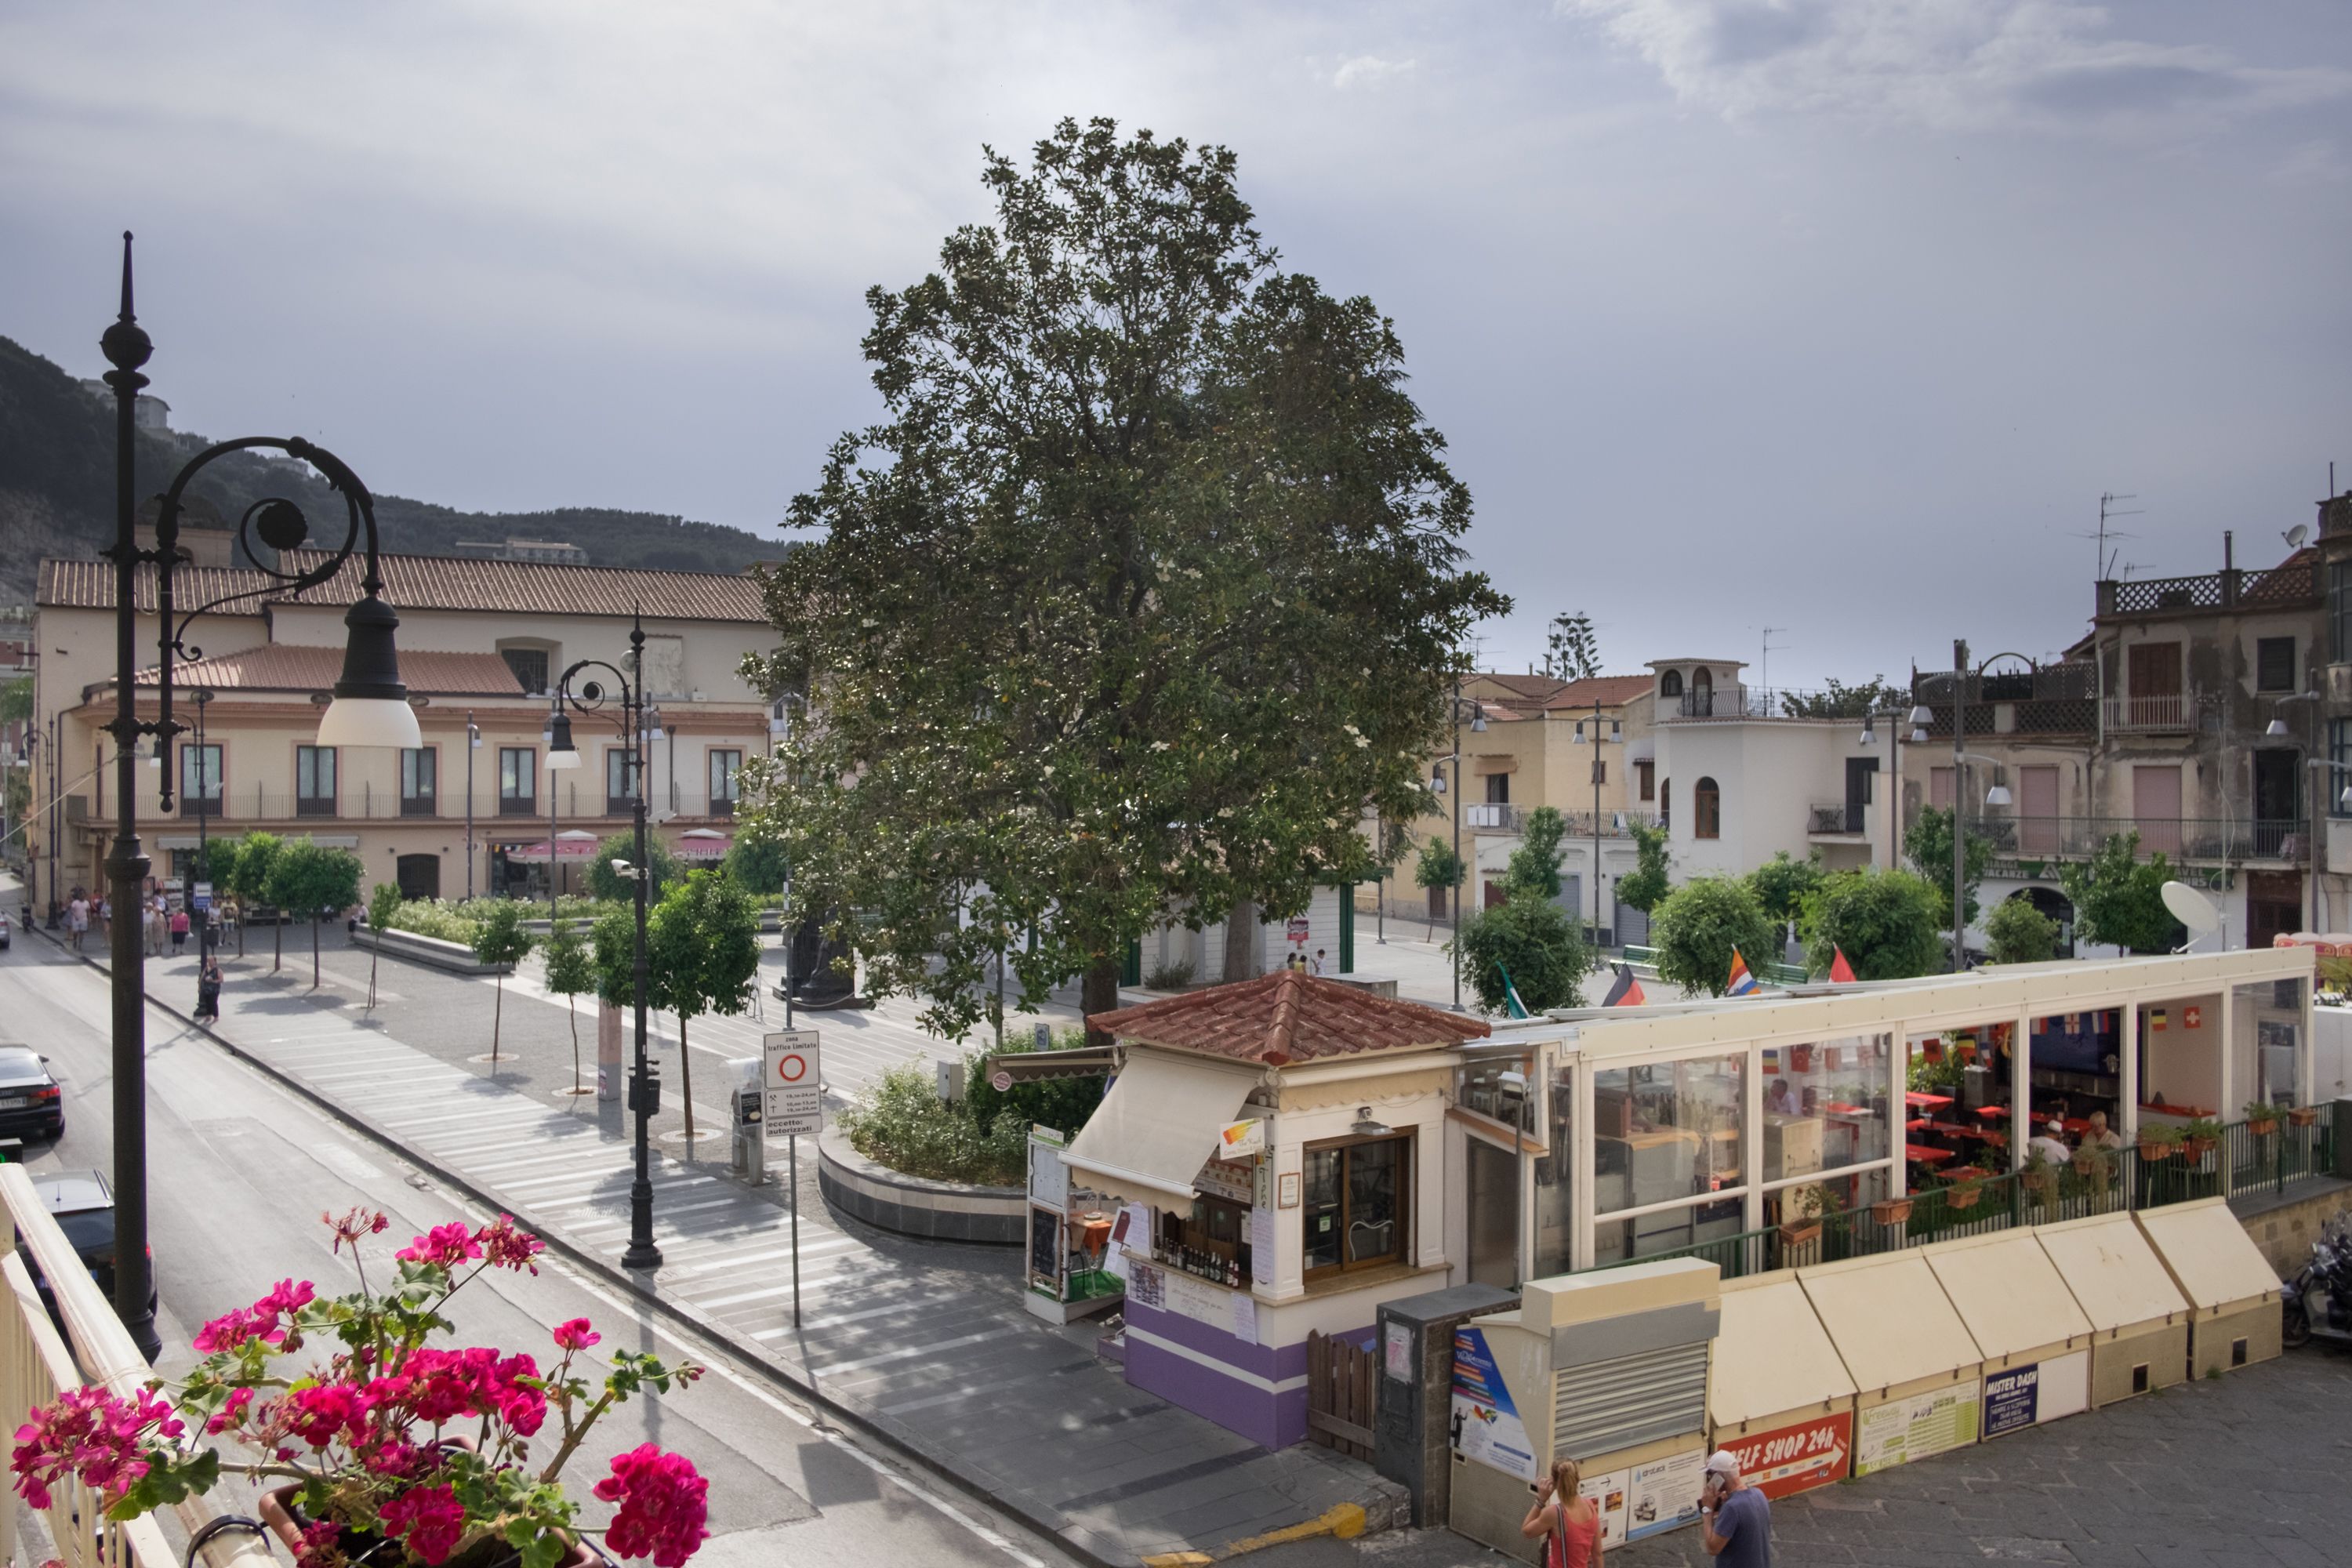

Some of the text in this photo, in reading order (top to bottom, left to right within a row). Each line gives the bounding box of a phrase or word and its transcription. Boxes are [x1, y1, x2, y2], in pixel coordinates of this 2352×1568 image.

[1982, 869, 2029, 879] VACANZE
[768, 1125, 812, 1134] autorizzati
[1985, 1377, 2016, 1396] MISTER
[2016, 1370, 2038, 1388] DASH
[1731, 1443, 1762, 1470] ELF
[1762, 1432, 1806, 1465] SHOP
[1807, 1425, 1835, 1452] 24h
